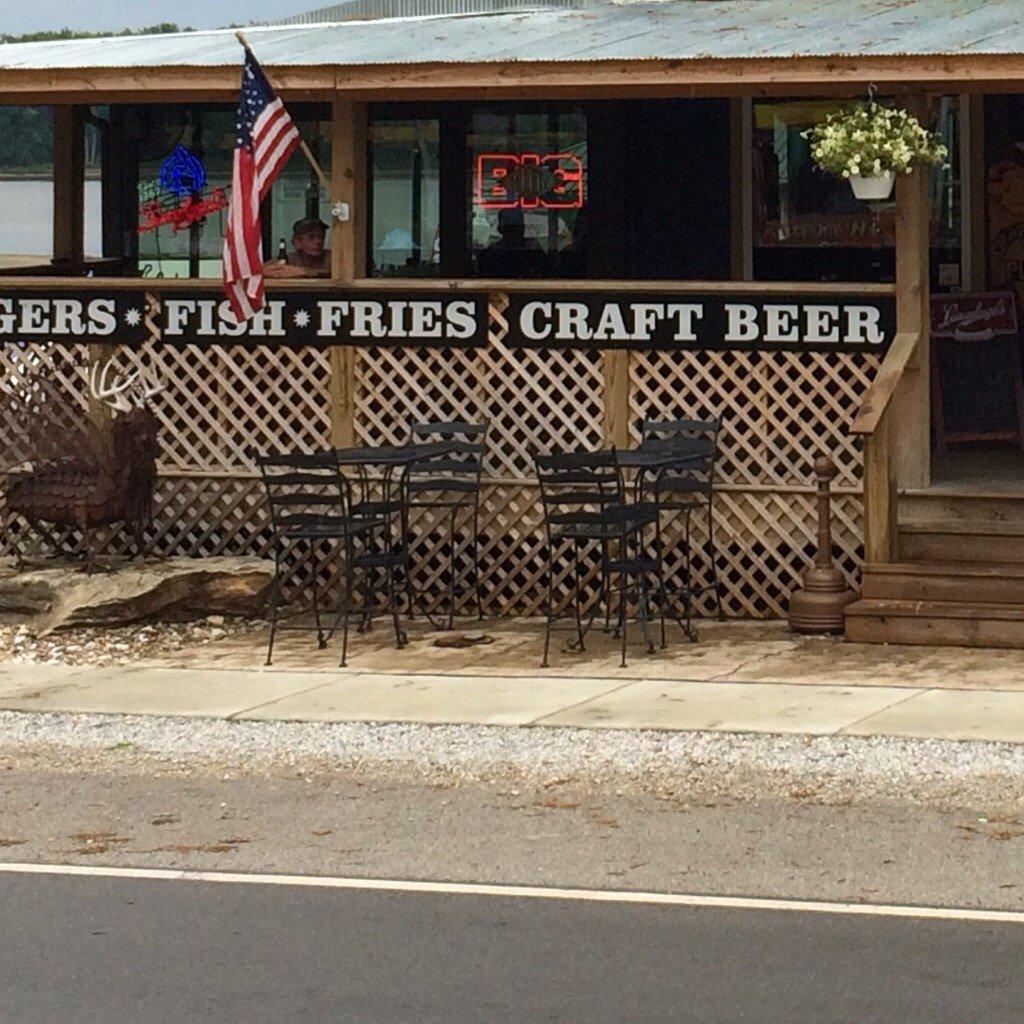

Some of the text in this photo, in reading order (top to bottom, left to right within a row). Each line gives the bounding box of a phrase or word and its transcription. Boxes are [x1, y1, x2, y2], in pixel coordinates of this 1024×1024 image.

[164, 300, 477, 338] FISH FRIES
[519, 301, 885, 344] CRAFT BEER
